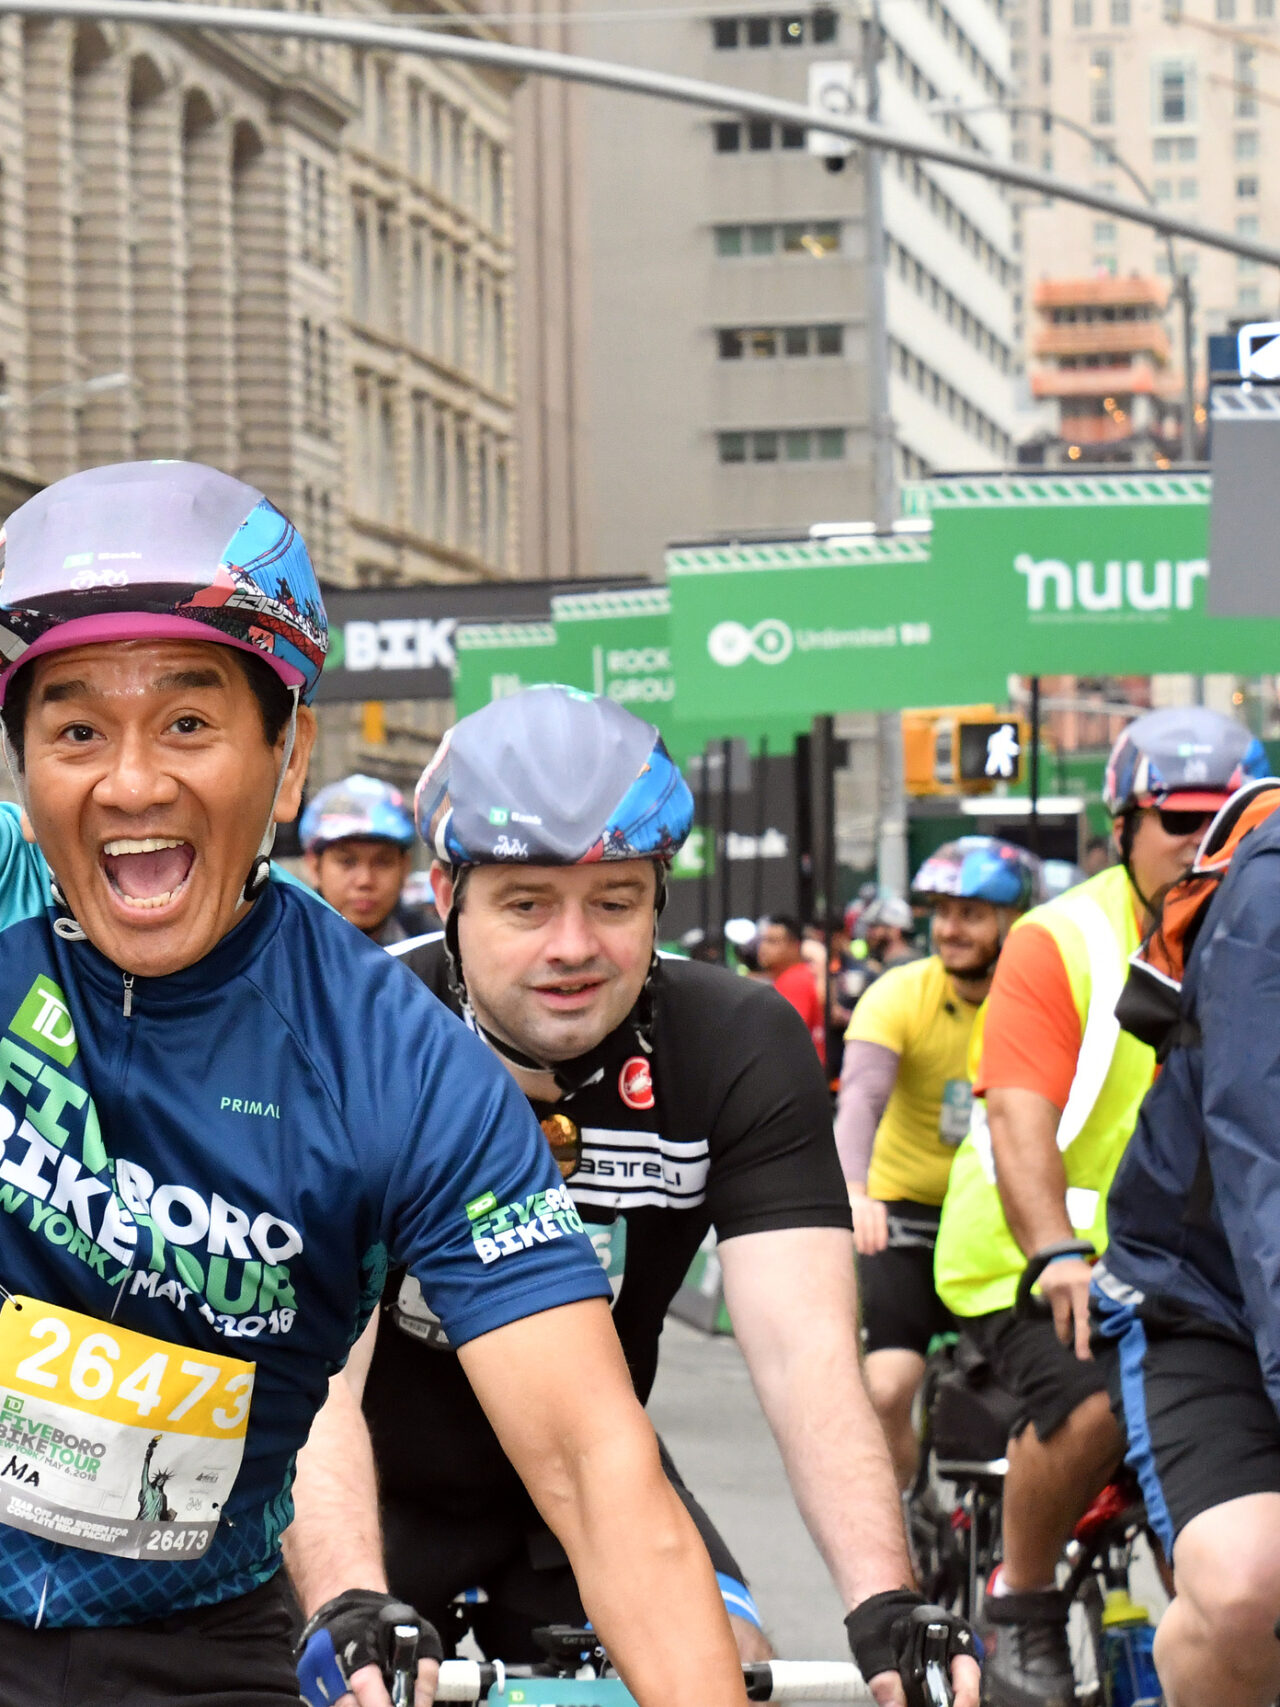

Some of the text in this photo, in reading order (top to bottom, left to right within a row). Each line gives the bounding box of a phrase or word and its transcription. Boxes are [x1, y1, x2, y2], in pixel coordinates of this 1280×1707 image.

[344, 618, 457, 672] BIK
[608, 647, 670, 673] ROCK
[608, 678, 675, 703] GROU
[30, 988, 77, 1048] TD
[220, 1096, 281, 1120] PRIMAL
[129, 1270, 194, 1312] MAY
[15, 1316, 255, 1430] 26473
[0, 1455, 41, 1487] MA
[6, 1505, 120, 1543] COMPLETE RIDER PACKET
[10, 1496, 129, 1538] TEAR OFF AND REDEEM FOR
[146, 1529, 210, 1551] 26473
